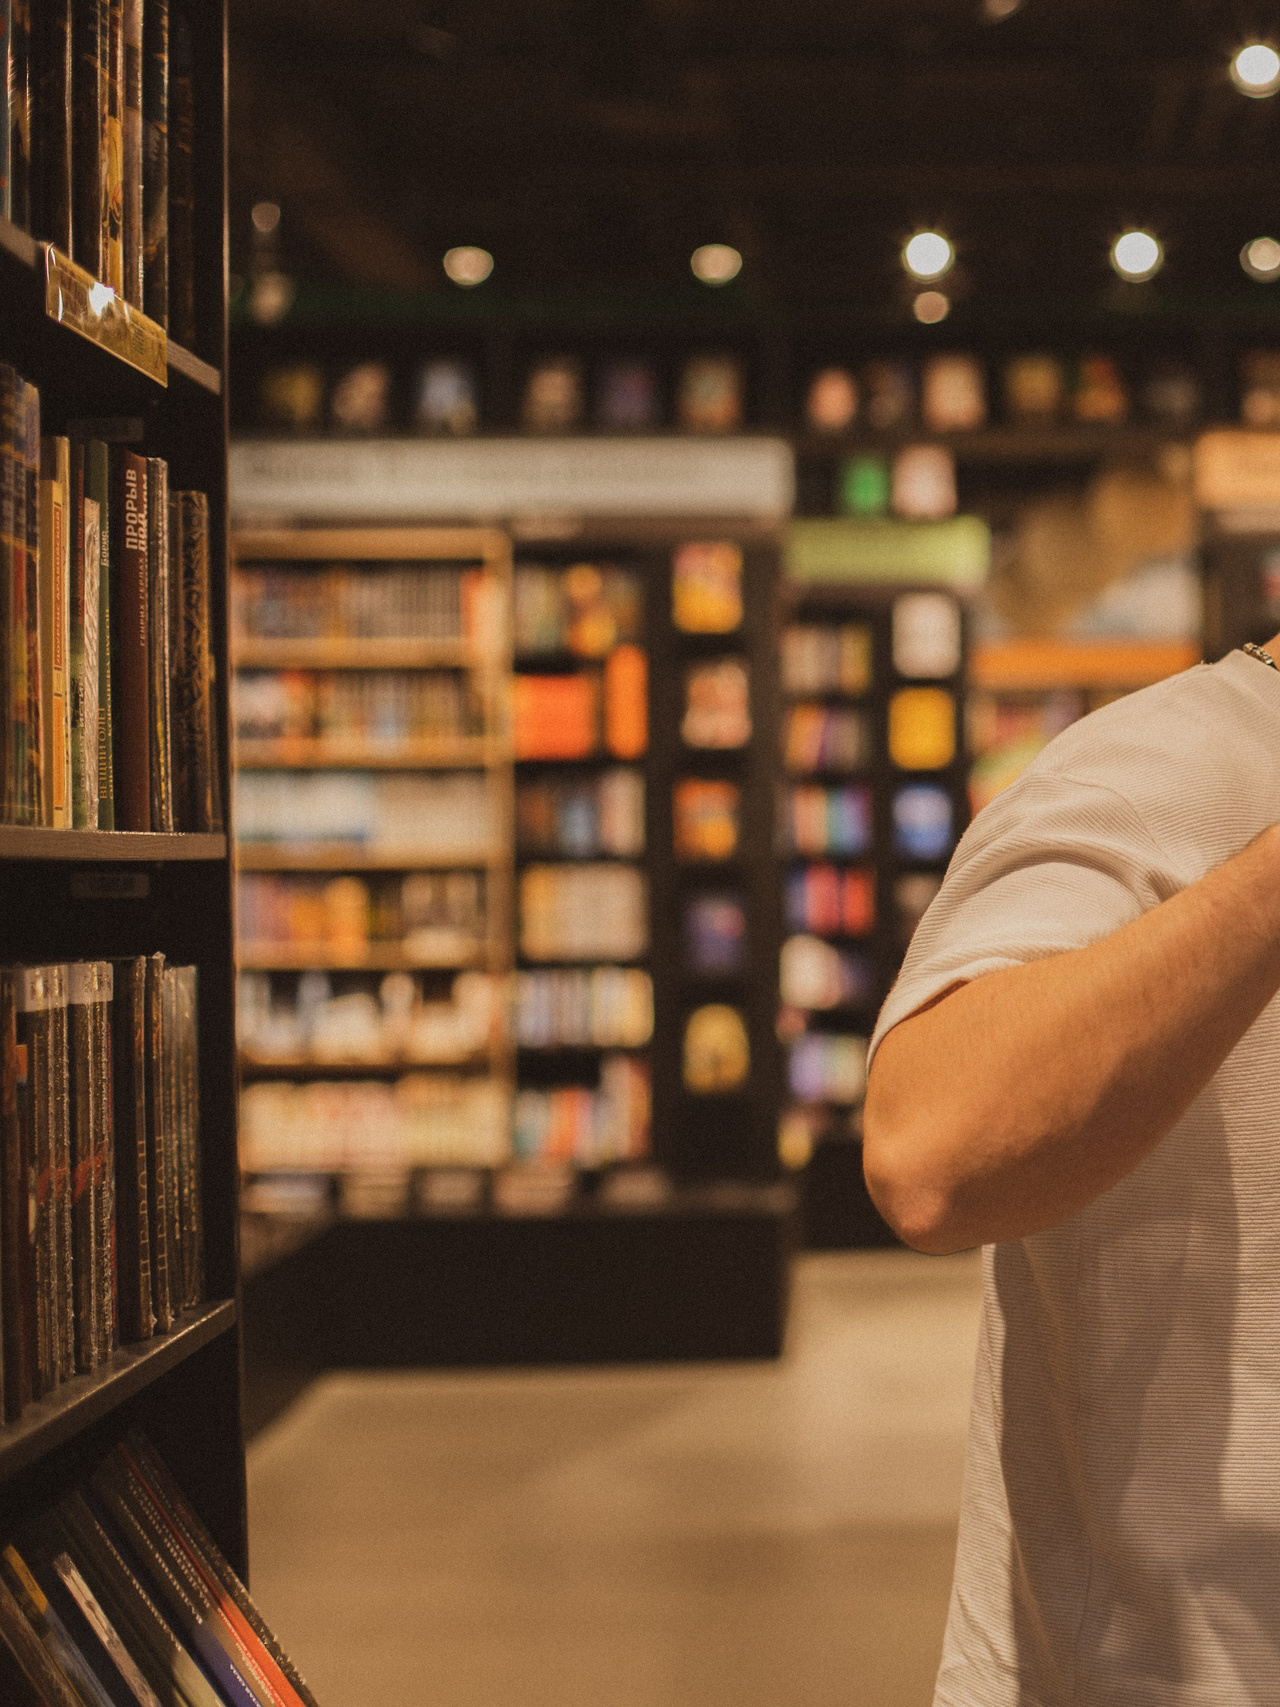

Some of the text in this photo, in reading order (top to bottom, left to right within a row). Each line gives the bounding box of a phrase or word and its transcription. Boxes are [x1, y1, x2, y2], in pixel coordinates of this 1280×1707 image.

[100, 531, 108, 566] Борис
[125, 469, 138, 549] ПРОРЫВ
[98, 707, 108, 799] ВЕЩИЙ ОЛЕГ
